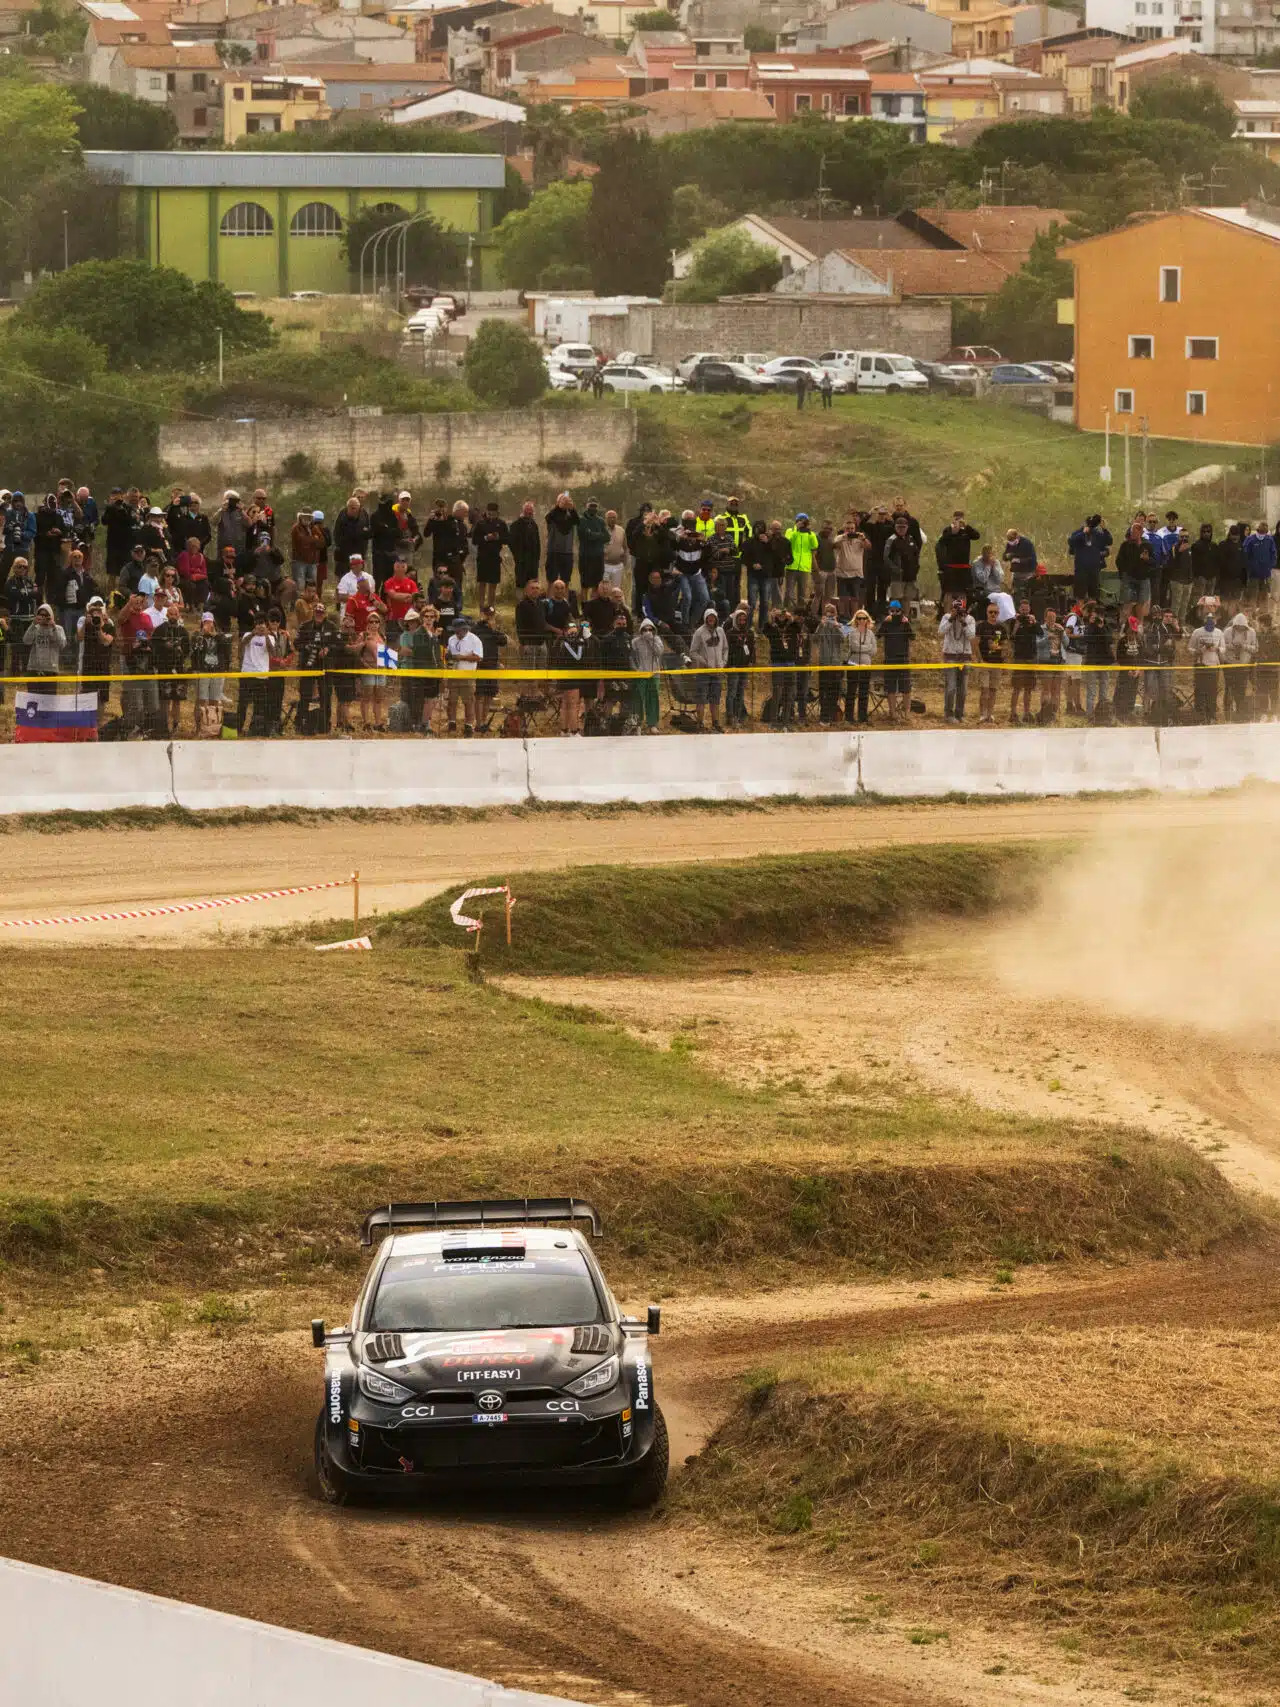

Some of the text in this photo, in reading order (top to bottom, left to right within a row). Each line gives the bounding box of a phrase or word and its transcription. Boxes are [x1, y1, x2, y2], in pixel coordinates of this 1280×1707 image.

[442, 1354, 535, 1366] DENSO
[635, 1356, 649, 1410] Panason
[330, 1367, 345, 1424] nasonic
